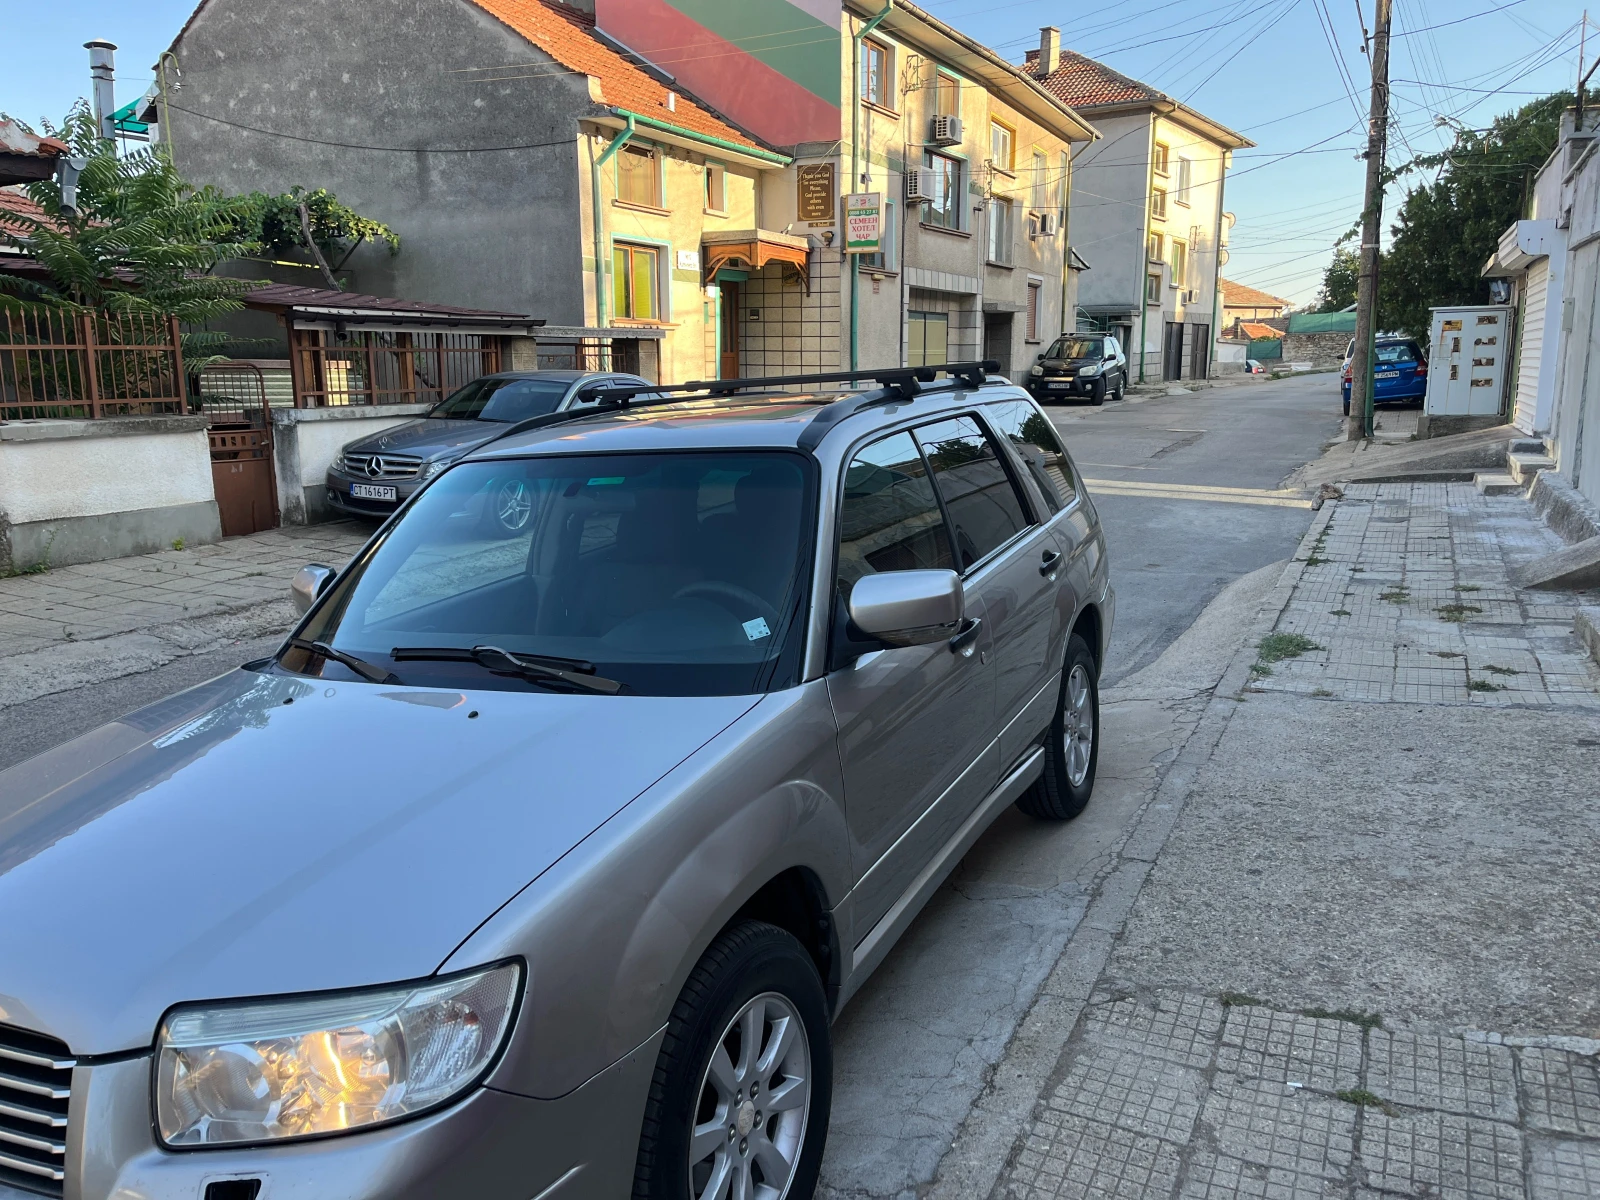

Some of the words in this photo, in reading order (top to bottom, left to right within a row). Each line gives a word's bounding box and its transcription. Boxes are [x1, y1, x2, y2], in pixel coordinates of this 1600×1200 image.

[354, 486, 362, 495] CT
[364, 486, 382, 497] 1616
[383, 488, 394, 498] PT
